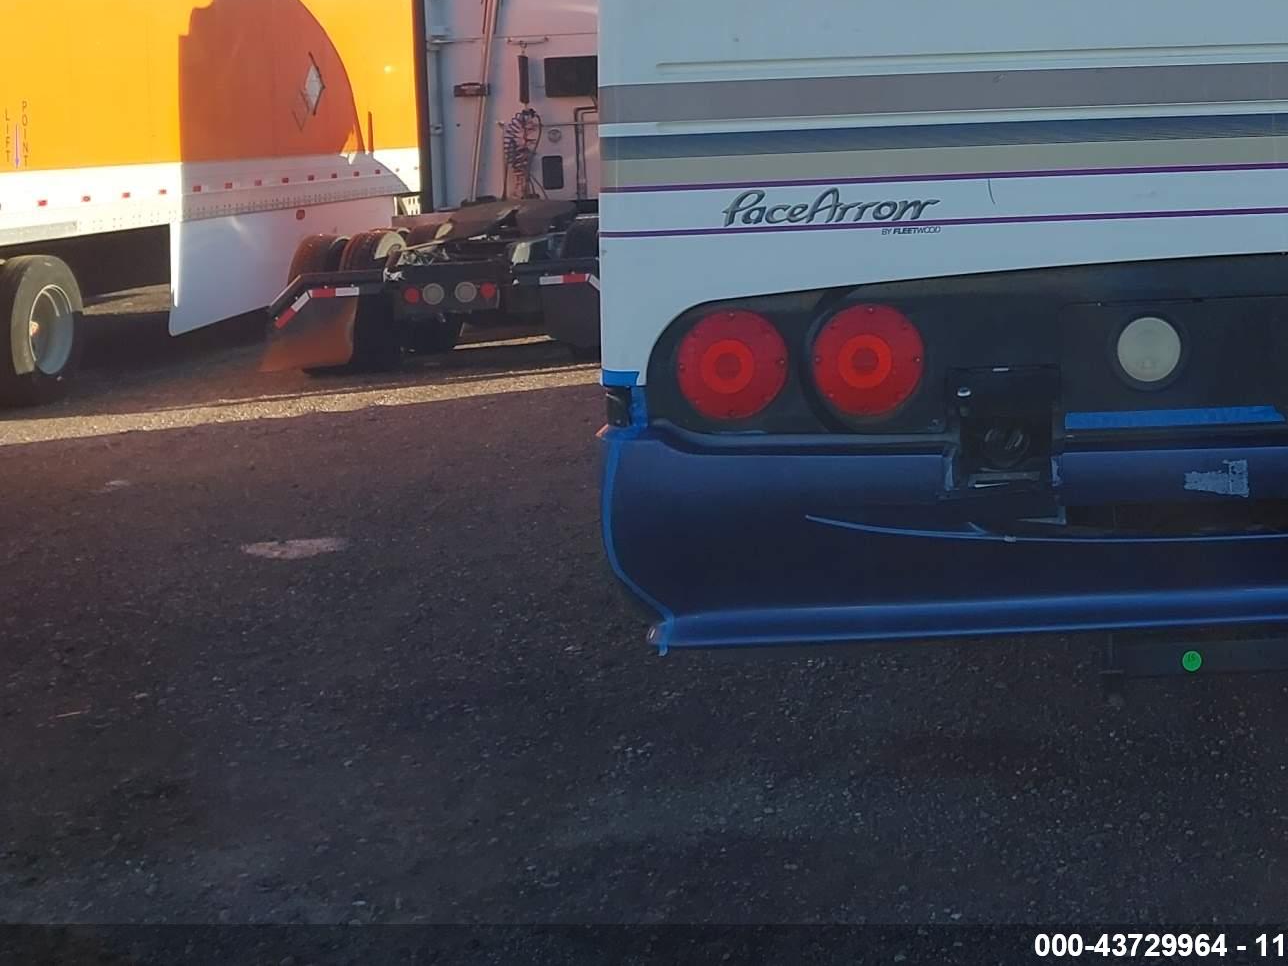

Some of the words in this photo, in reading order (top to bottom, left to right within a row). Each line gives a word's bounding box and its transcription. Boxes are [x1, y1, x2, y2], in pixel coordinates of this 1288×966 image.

[21, 99, 29, 168] POINT
[722, 187, 941, 227] PaceArrow
[881, 227, 892, 236] BY
[893, 225, 942, 235] FLEETWOOD
